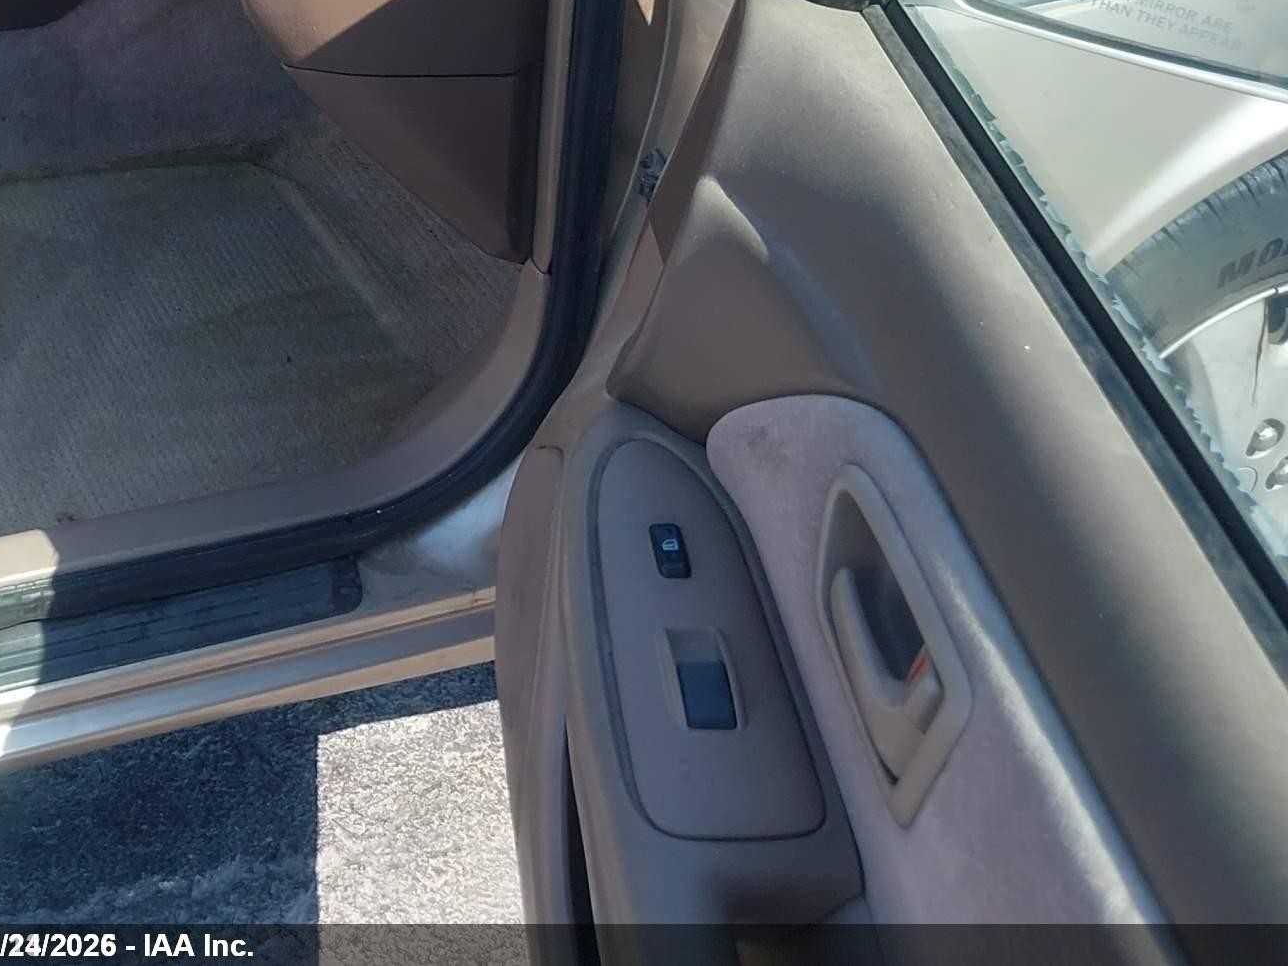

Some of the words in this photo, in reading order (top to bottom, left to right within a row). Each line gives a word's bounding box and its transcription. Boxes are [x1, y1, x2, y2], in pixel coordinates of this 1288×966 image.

[1135, 10, 1175, 32] THEY
[1176, 25, 1242, 51] APPEAR
[1200, 15, 1235, 34] ARE
